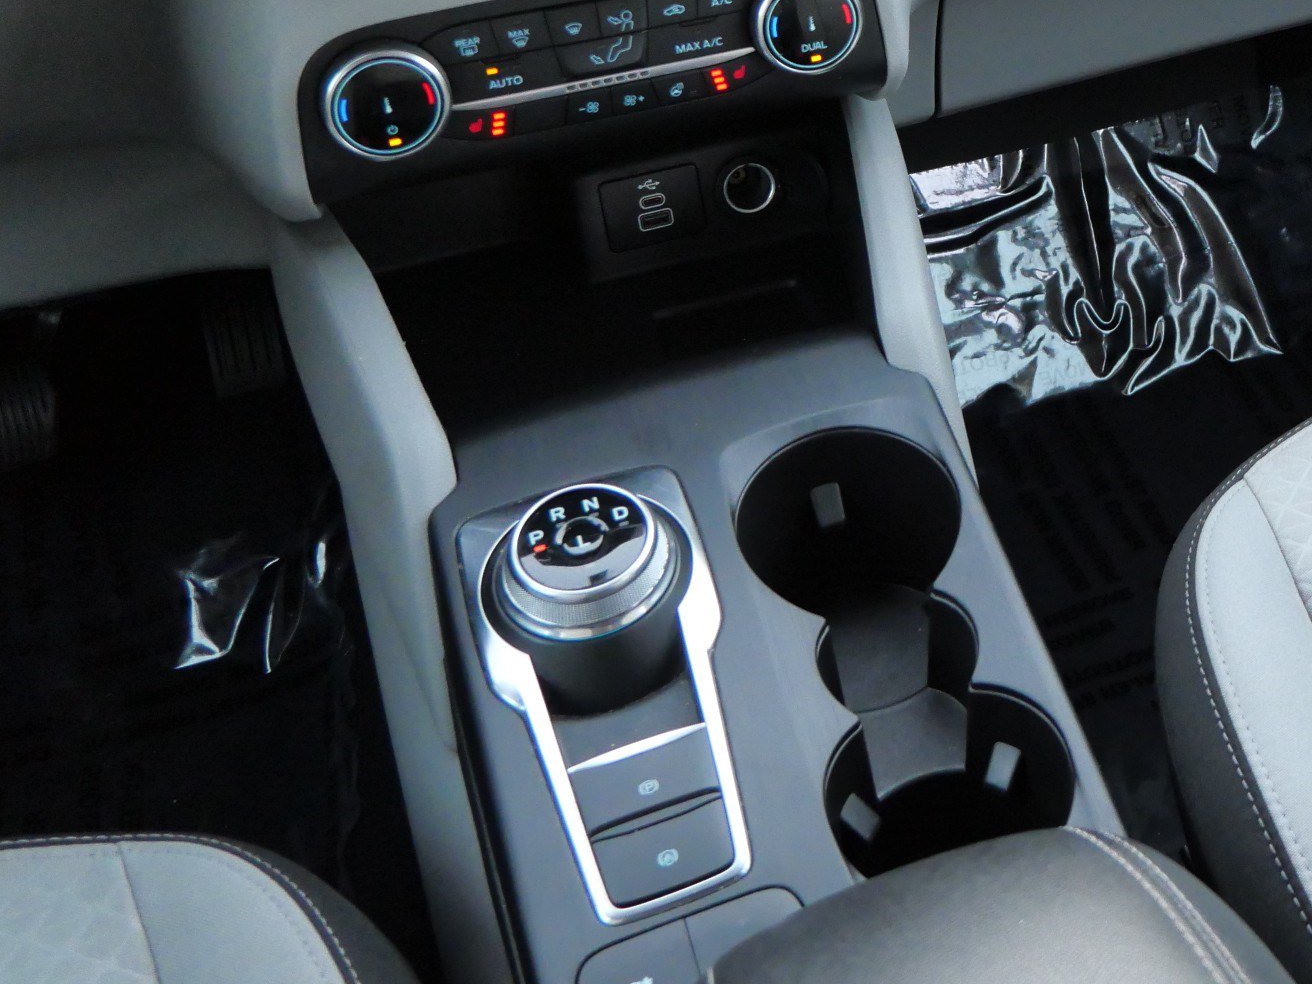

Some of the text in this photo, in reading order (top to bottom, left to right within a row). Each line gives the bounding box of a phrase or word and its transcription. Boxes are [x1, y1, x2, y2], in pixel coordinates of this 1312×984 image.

[507, 27, 531, 39] MAX
[454, 35, 481, 48] REAR
[675, 36, 724, 55] MAX A/C
[800, 40, 828, 53] DUAL
[488, 74, 524, 90] AUTO
[528, 496, 629, 546] P R N D
[576, 534, 592, 549] L
